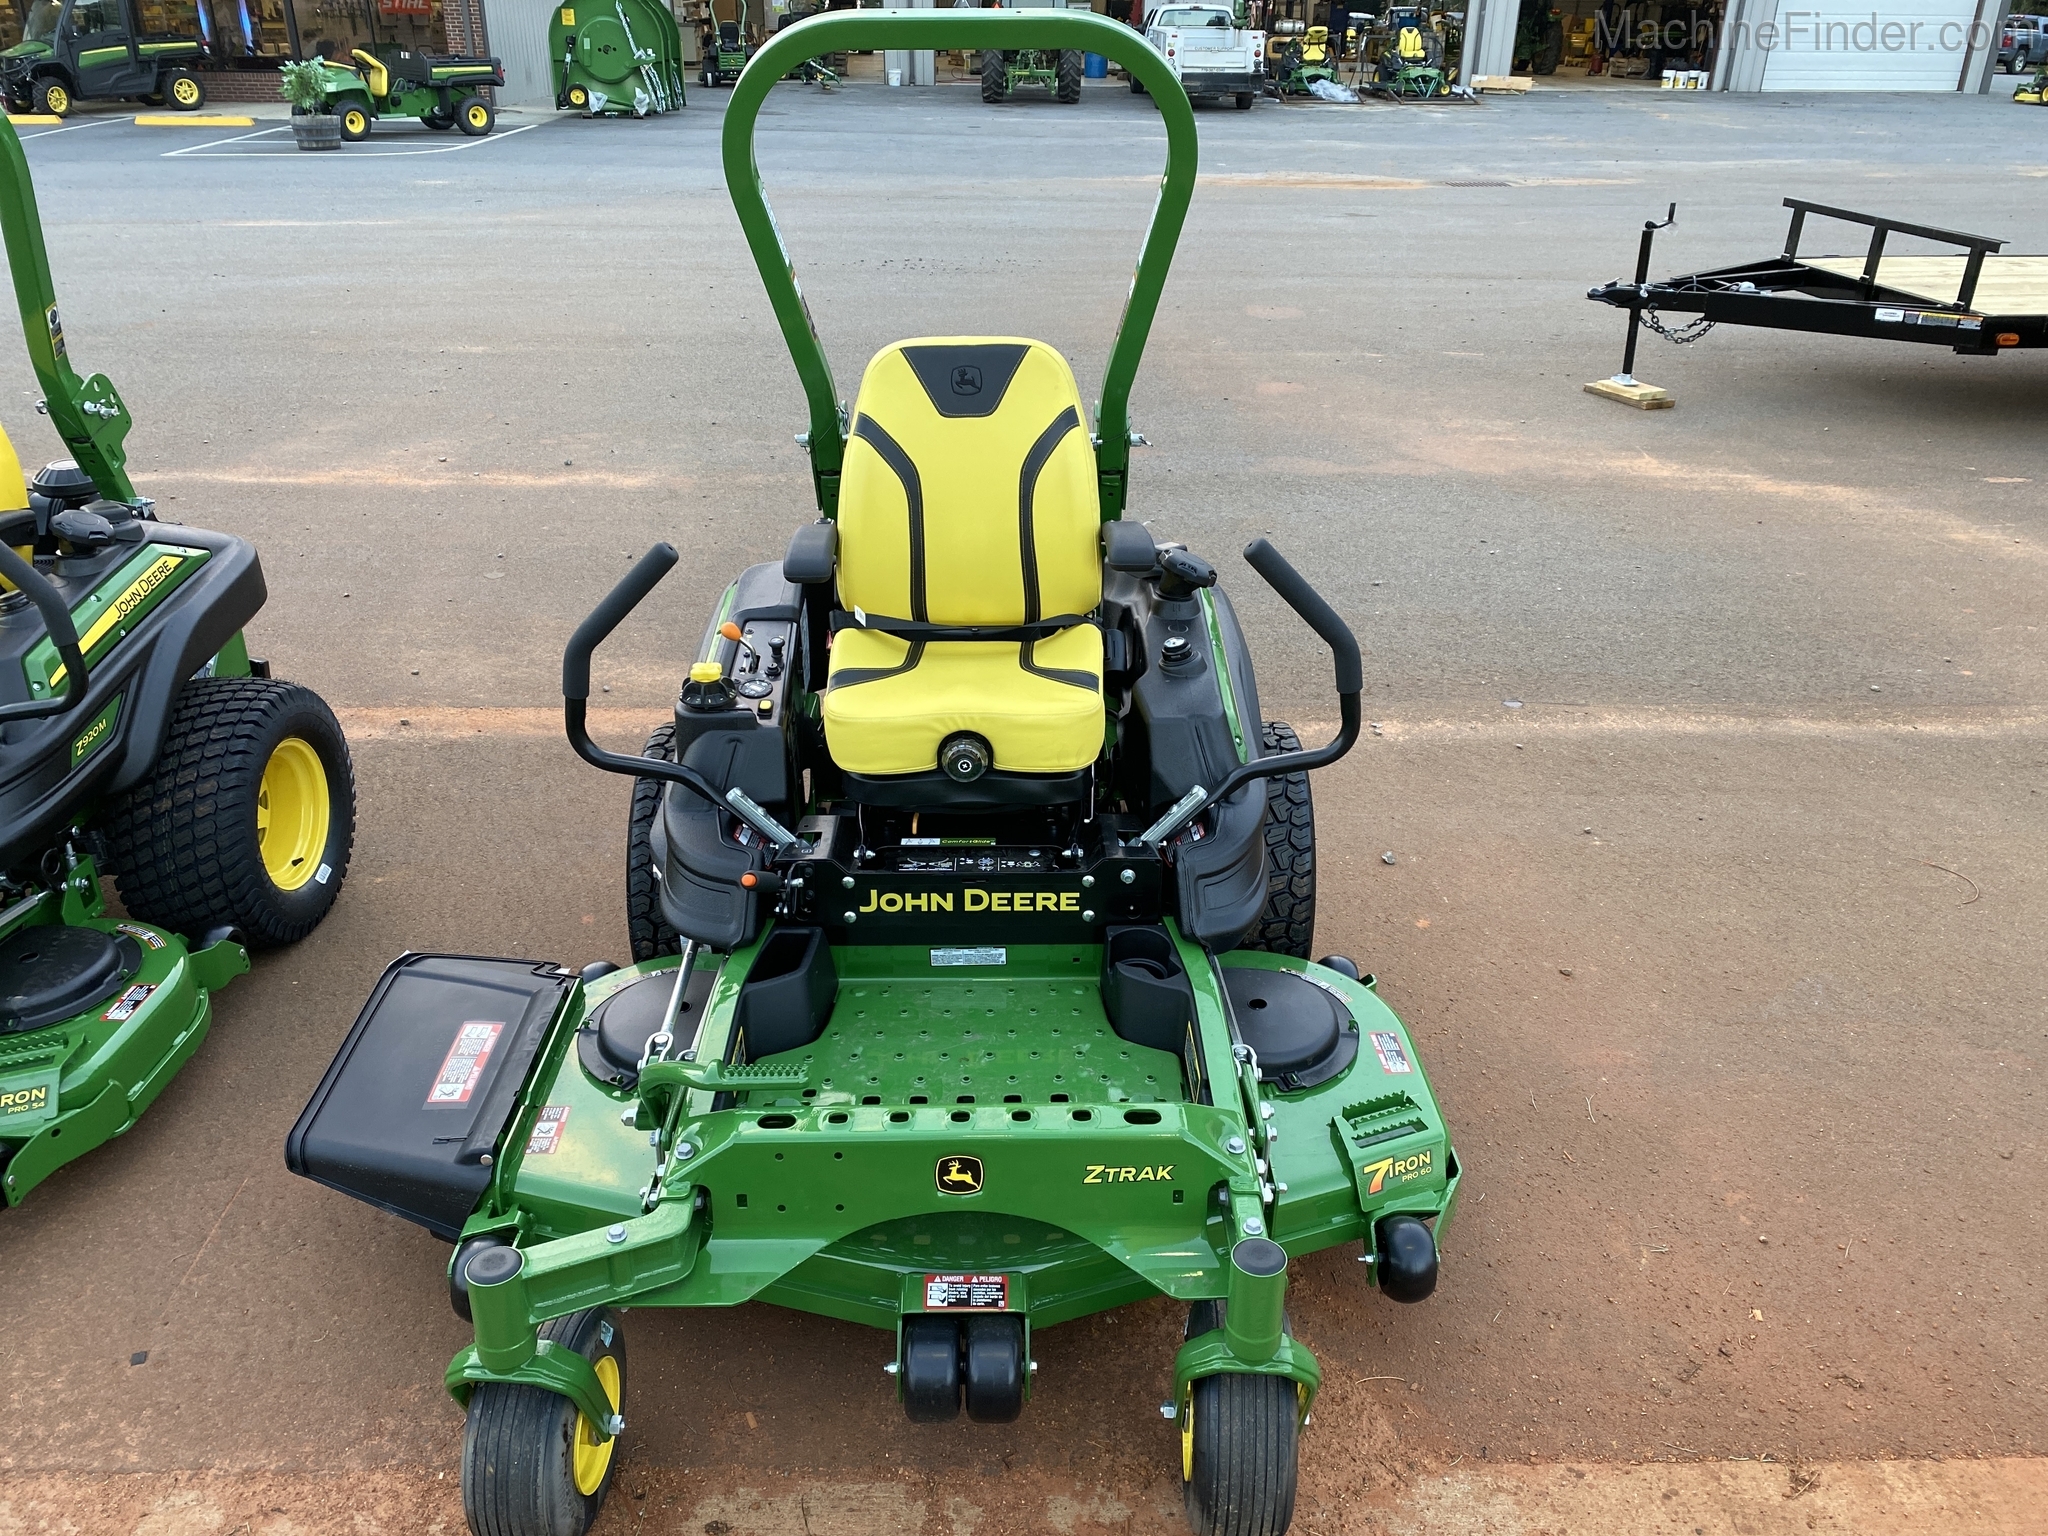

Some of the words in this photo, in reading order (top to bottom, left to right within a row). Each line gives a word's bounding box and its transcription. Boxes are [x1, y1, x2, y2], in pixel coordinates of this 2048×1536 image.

[114, 588, 141, 620] JOHN
[139, 561, 173, 593] DEERE
[75, 717, 107, 757] Z920M
[859, 889, 954, 913] JOHN
[964, 888, 1080, 912] DEERE
[7, 1104, 29, 1115] PRO
[31, 1101, 45, 1110] 54
[1083, 1164, 1175, 1184] ZTRAK
[1402, 1171, 1419, 1183] PRO
[1420, 1166, 1432, 1176] 60
